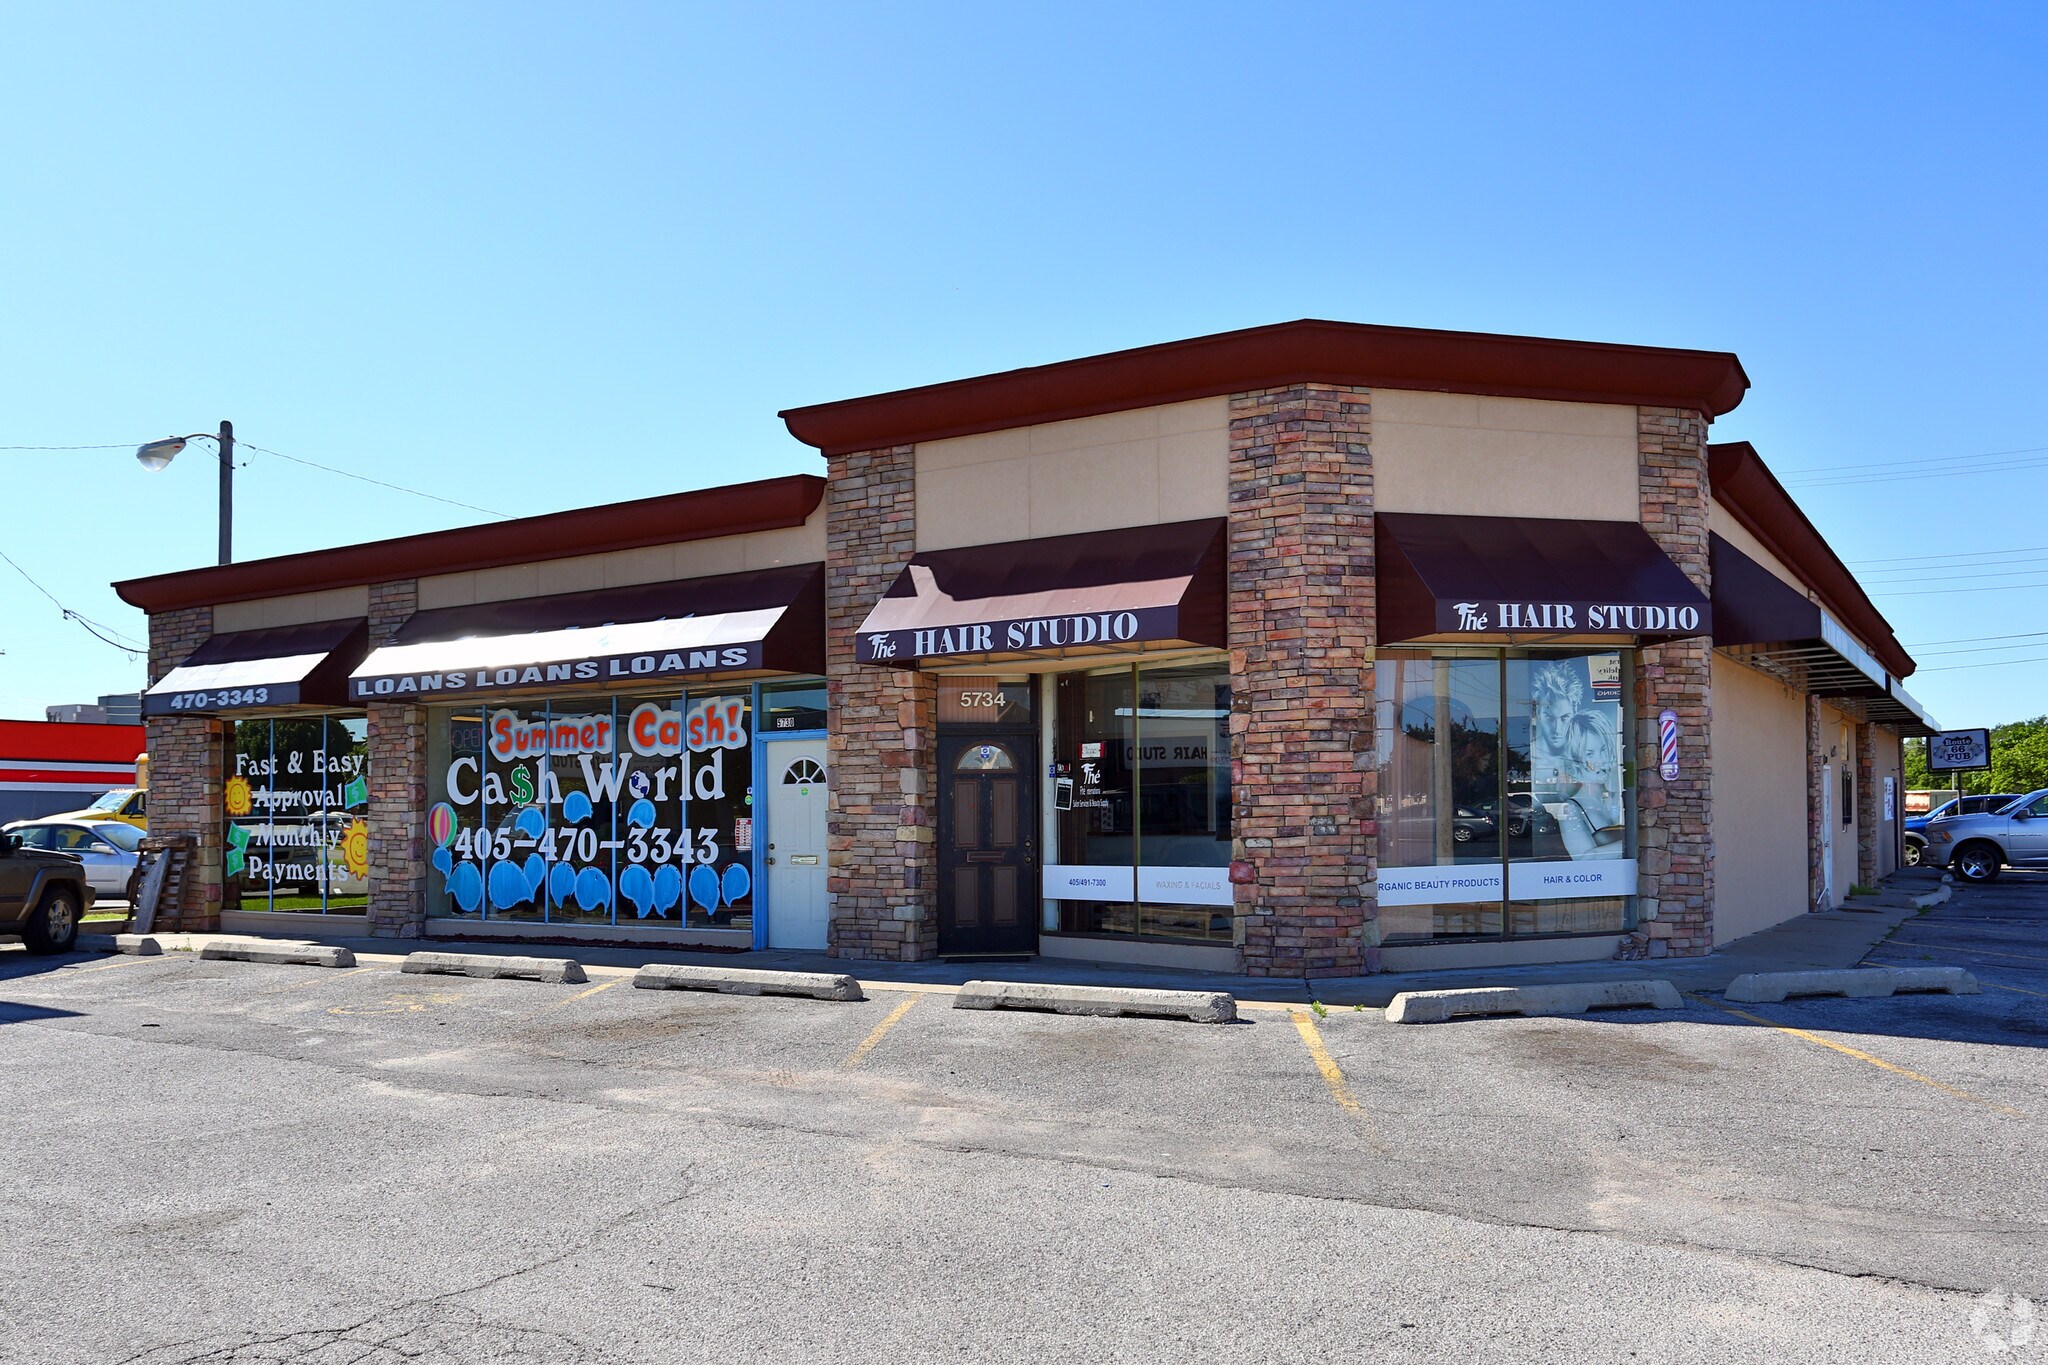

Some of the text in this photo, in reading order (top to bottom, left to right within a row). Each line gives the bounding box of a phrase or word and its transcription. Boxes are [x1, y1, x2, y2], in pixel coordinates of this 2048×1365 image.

[1497, 603, 1577, 629] HAIR
[1588, 604, 1699, 631] STUDIO
[912, 624, 995, 657] HAIR
[1006, 612, 1139, 650] STUDIO
[357, 647, 749, 698] LOANS LOANS LOANS
[170, 687, 269, 710] 470-3343
[960, 692, 1006, 707] 5734
[493, 702, 742, 756] Summer Cash!
[777, 717, 795, 728] 5730
[235, 749, 364, 776] Fast & Easy
[253, 784, 343, 812] Approval
[256, 823, 341, 851] Monthly
[455, 826, 719, 865] 405-470-3343
[248, 856, 349, 884] Payments
[1069, 878, 1107, 887] 405/491-7300
[1543, 873, 1603, 884] HAIR & COLOR
[1155, 881, 1183, 889] WAXING
[1191, 881, 1221, 890] FACIALS
[1414, 880, 1450, 890] BEAUTY
[1452, 878, 1500, 888] PRODUCTS
